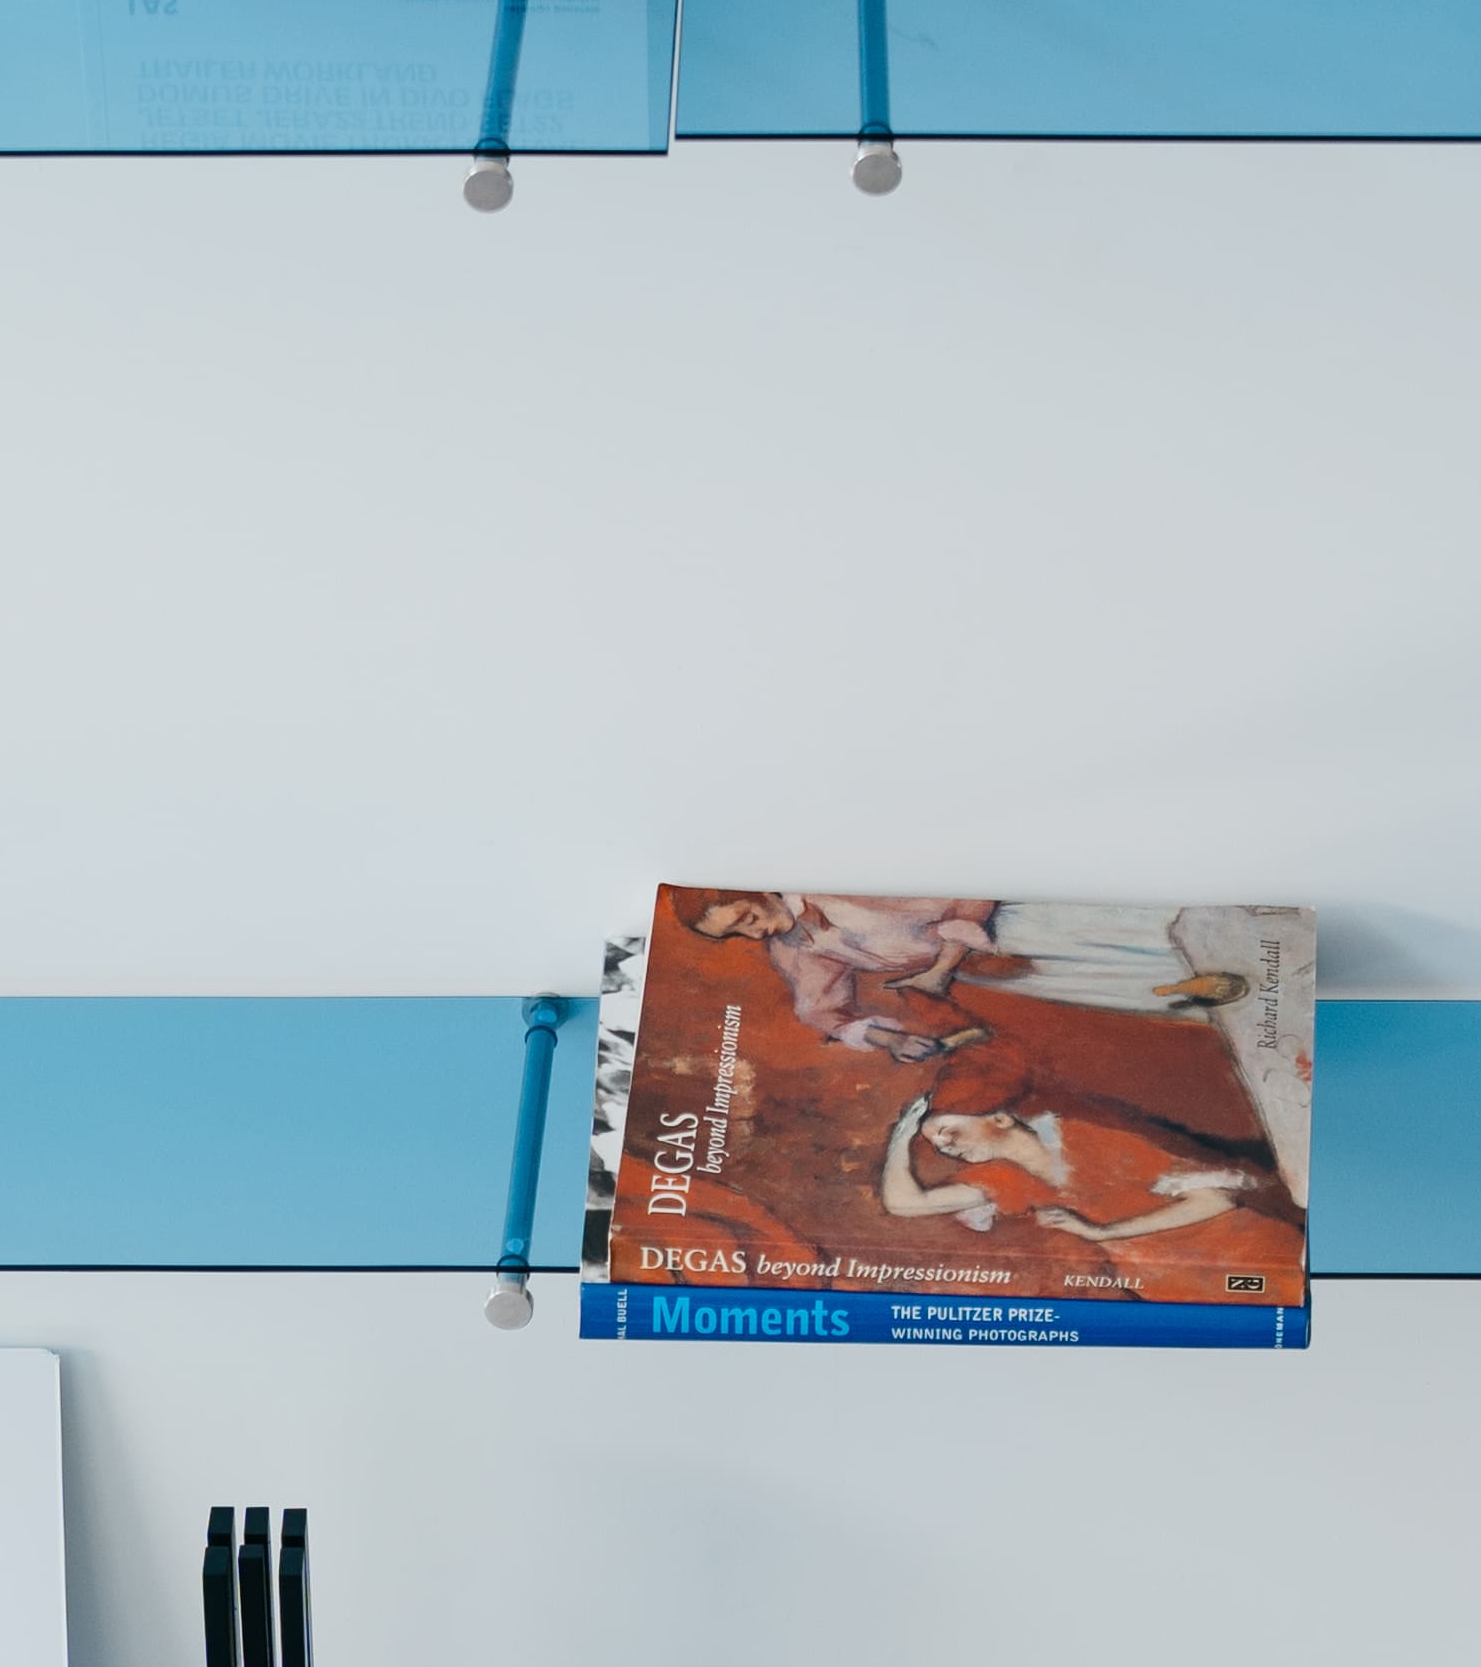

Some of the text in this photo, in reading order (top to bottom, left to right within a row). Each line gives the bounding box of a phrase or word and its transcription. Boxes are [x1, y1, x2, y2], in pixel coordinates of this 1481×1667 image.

[1256, 940, 1280, 1049] Richard Kendall
[697, 1004, 742, 1174] beyond Impressionism
[647, 1113, 699, 1216] DEGAS
[640, 1247, 1011, 1285] DEGAS beyond Impressionism
[1064, 1274, 1144, 1290] KENDALL
[617, 1289, 627, 1322] BUELL
[653, 1296, 850, 1336] Moments
[891, 1306, 1060, 1323] THE PULITZER PRIZE-
[891, 1328, 1079, 1343] WINNING PHOTOGRAPHS
